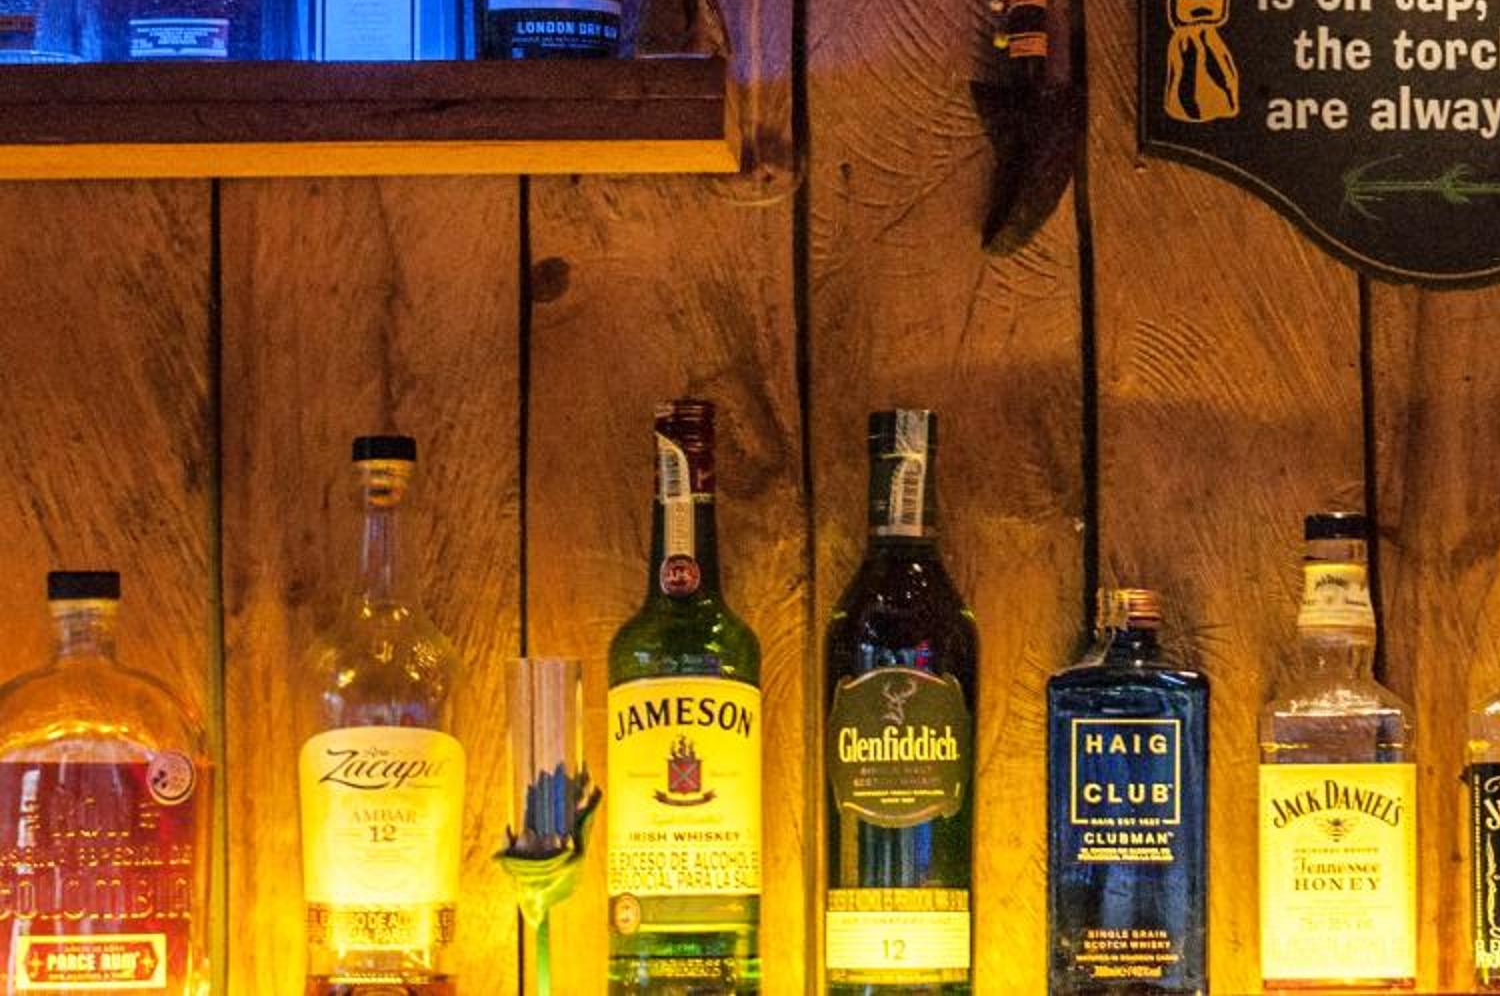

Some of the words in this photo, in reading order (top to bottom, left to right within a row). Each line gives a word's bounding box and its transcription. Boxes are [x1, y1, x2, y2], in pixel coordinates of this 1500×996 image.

[517, 21, 575, 35] LONDON
[1293, 27, 1372, 71] the
[1266, 96, 1348, 131] are
[615, 696, 752, 741] JAMESON
[839, 725, 958, 763] Glenfiddich
[1085, 734, 1168, 754] HAIG
[319, 747, 446, 791] Zacapa
[1083, 784, 1170, 803] CLUB
[1273, 786, 1323, 829] JACK
[1324, 779, 1404, 828] DANIEL'S
[369, 826, 397, 844] 12
[1084, 831, 1168, 845] CLUBMAN
[1294, 877, 1381, 892] HONEY
[1087, 929, 1129, 938] SINGLE
[881, 939, 907, 961] 12
[1083, 939, 1128, 949] SCOTCH
